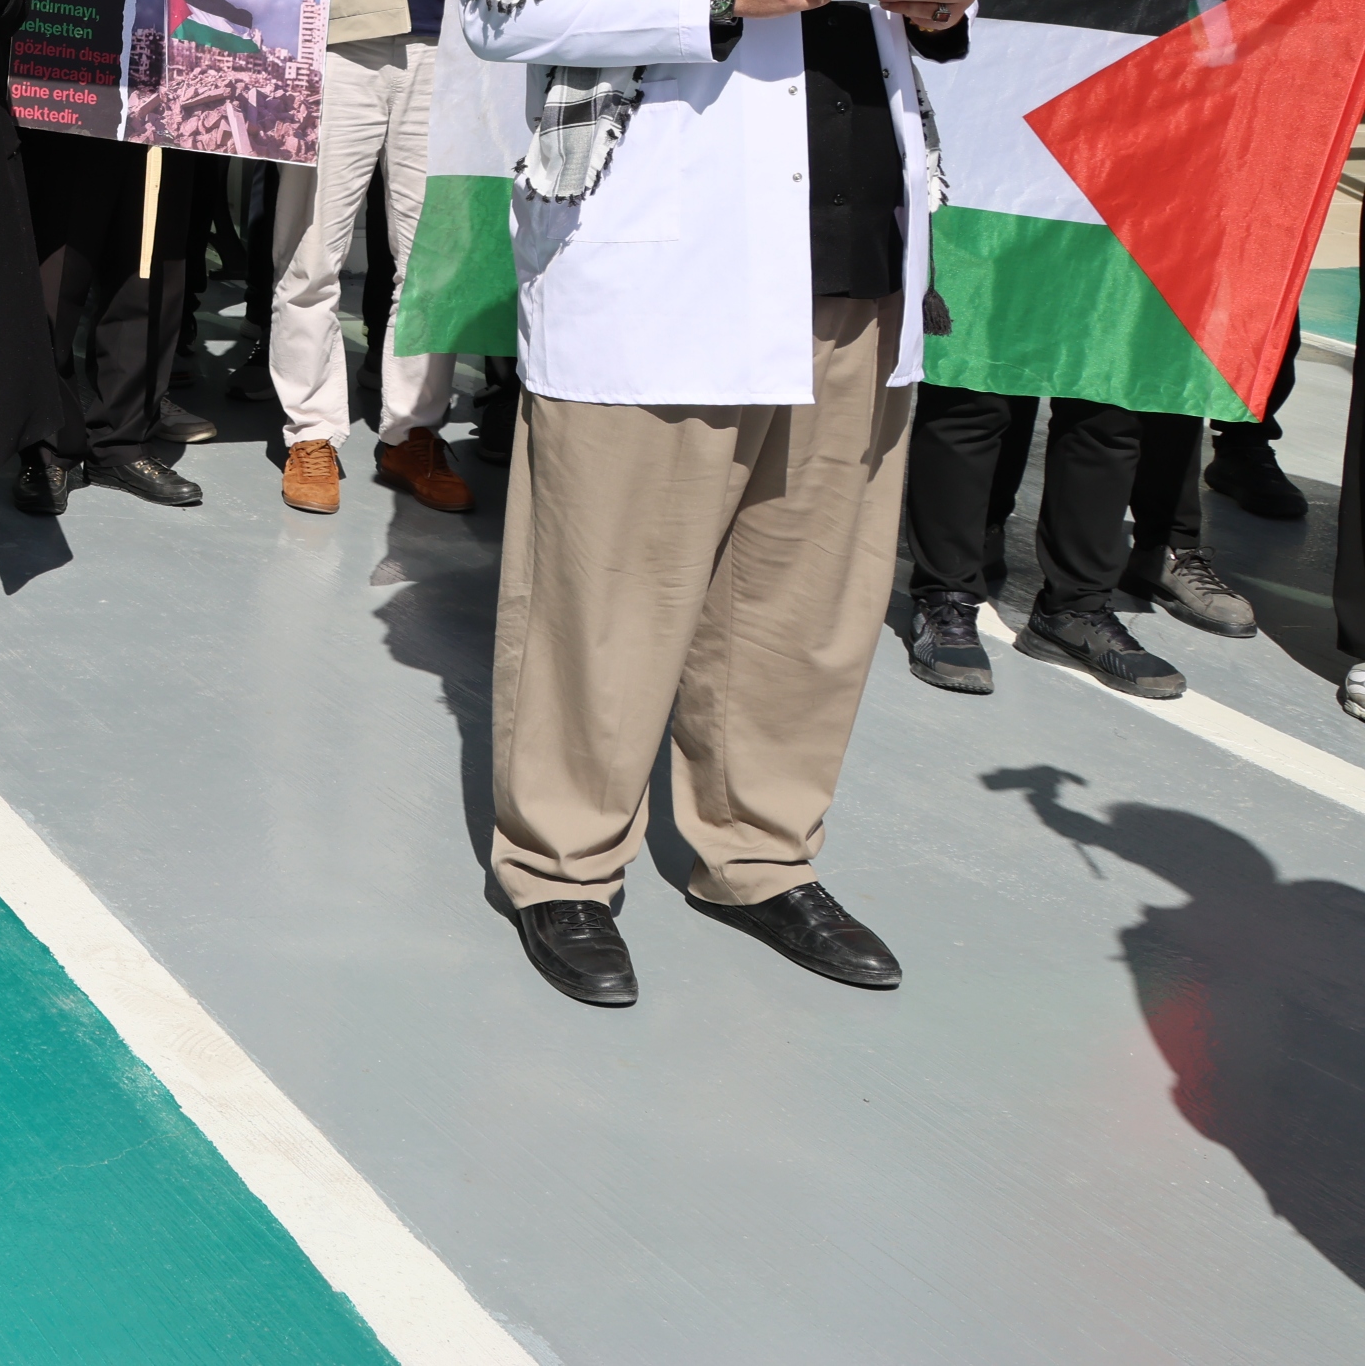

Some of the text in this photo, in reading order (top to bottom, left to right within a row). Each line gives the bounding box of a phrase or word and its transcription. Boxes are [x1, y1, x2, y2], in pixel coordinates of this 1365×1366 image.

[14, 40, 120, 66] gözlerin dışarı
[13, 60, 116, 85] fırlayacağı bir
[11, 82, 98, 105] güne ertele
[11, 105, 82, 125] mektedir.
